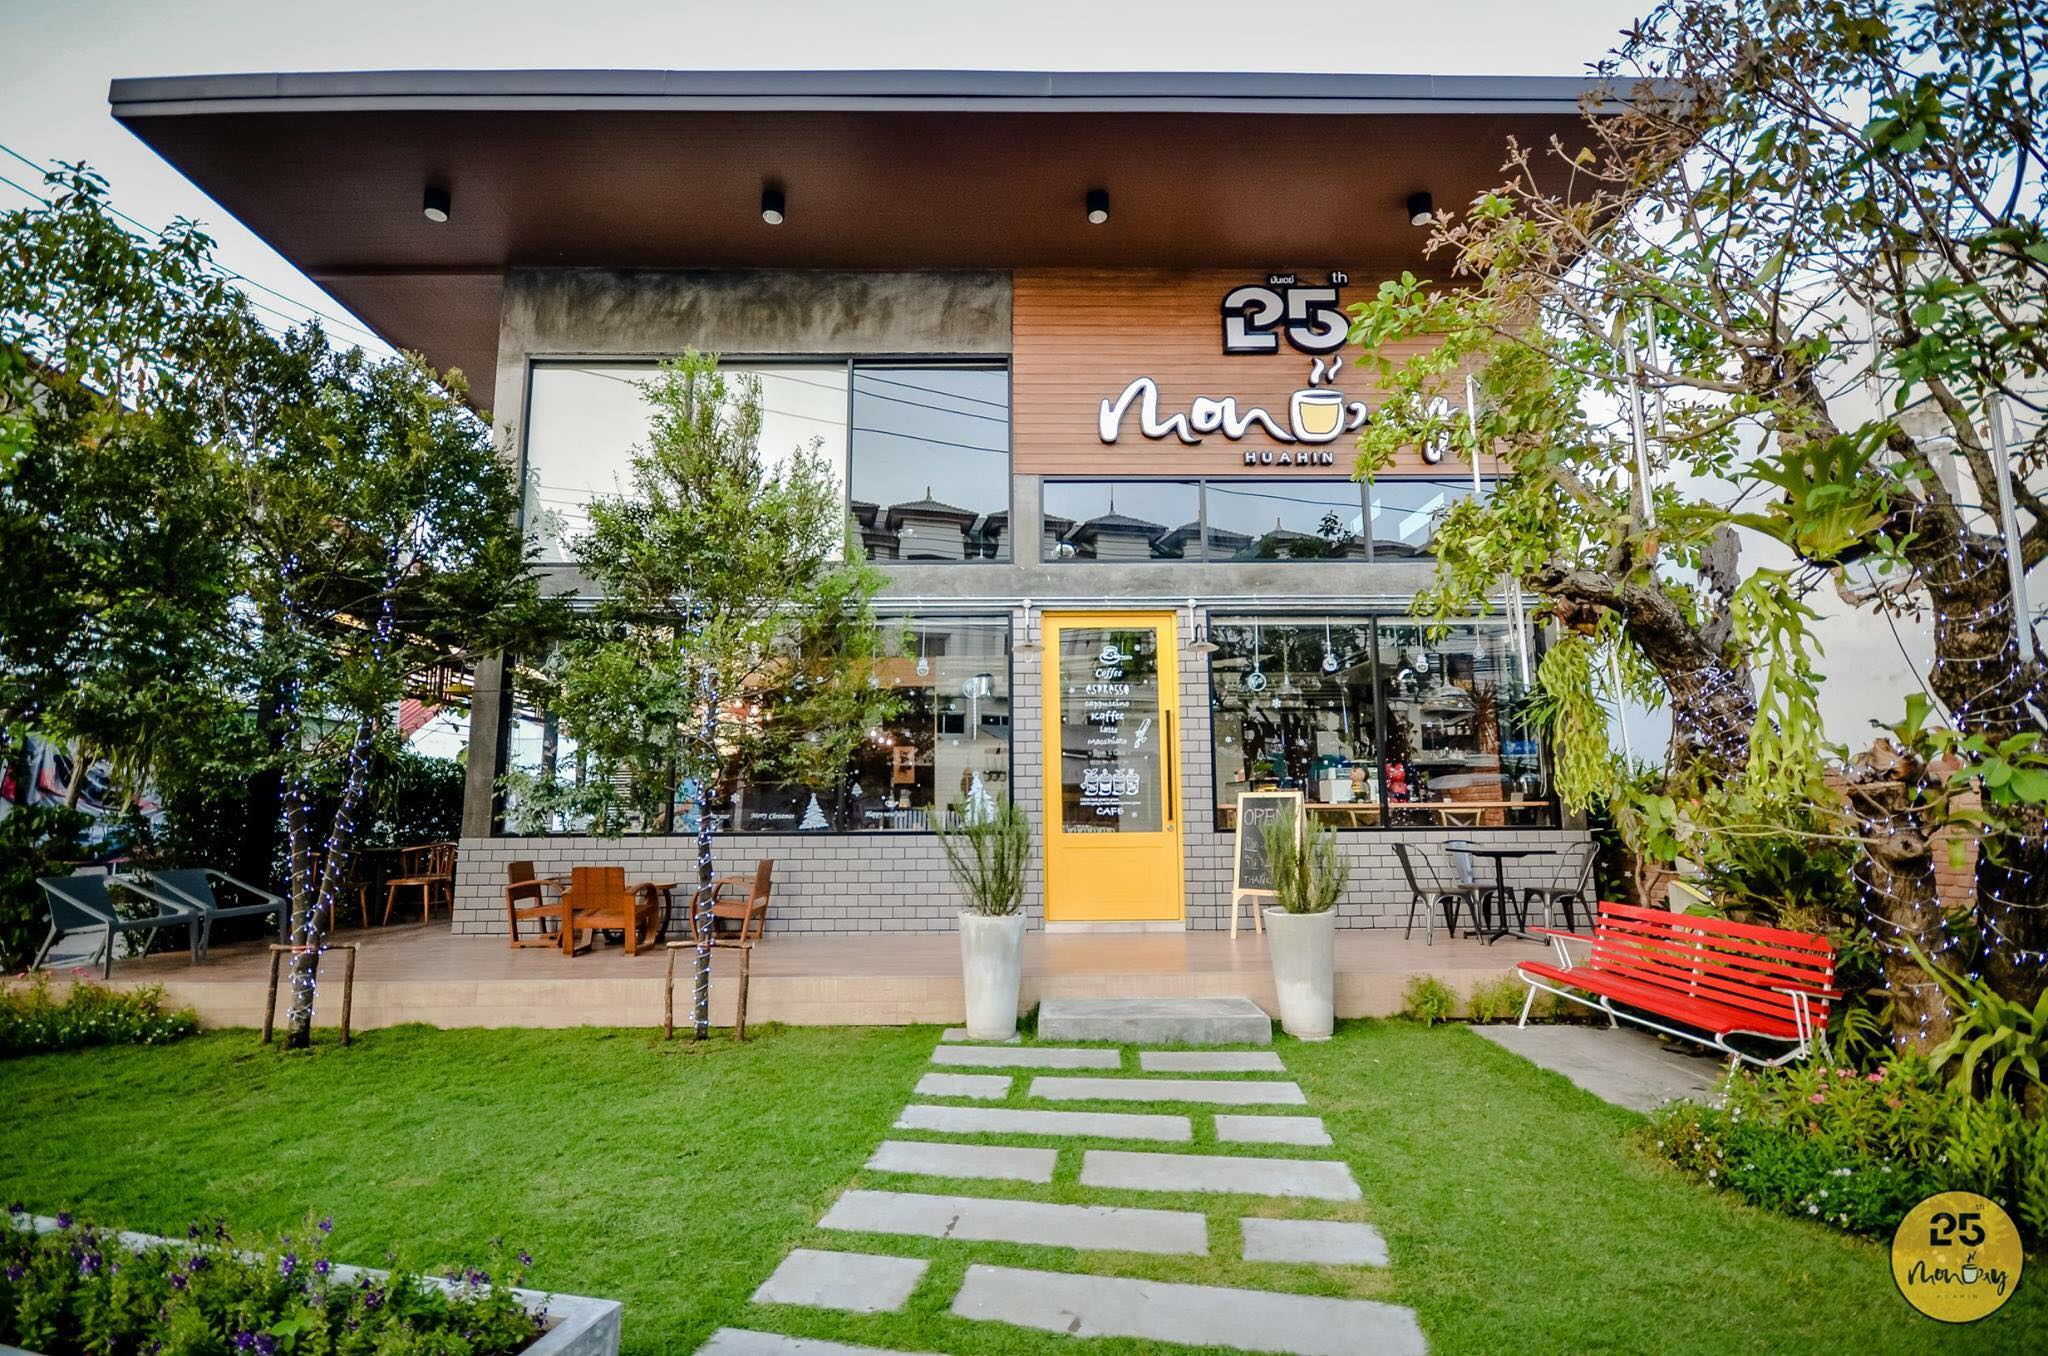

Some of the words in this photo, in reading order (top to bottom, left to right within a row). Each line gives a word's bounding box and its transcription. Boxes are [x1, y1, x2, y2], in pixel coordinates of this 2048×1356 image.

[1222, 286, 1350, 352] 25
[1244, 451, 1334, 466] HUAHIN
[1095, 667, 1123, 679] Coffee
[1244, 808, 1286, 826] OPEN
